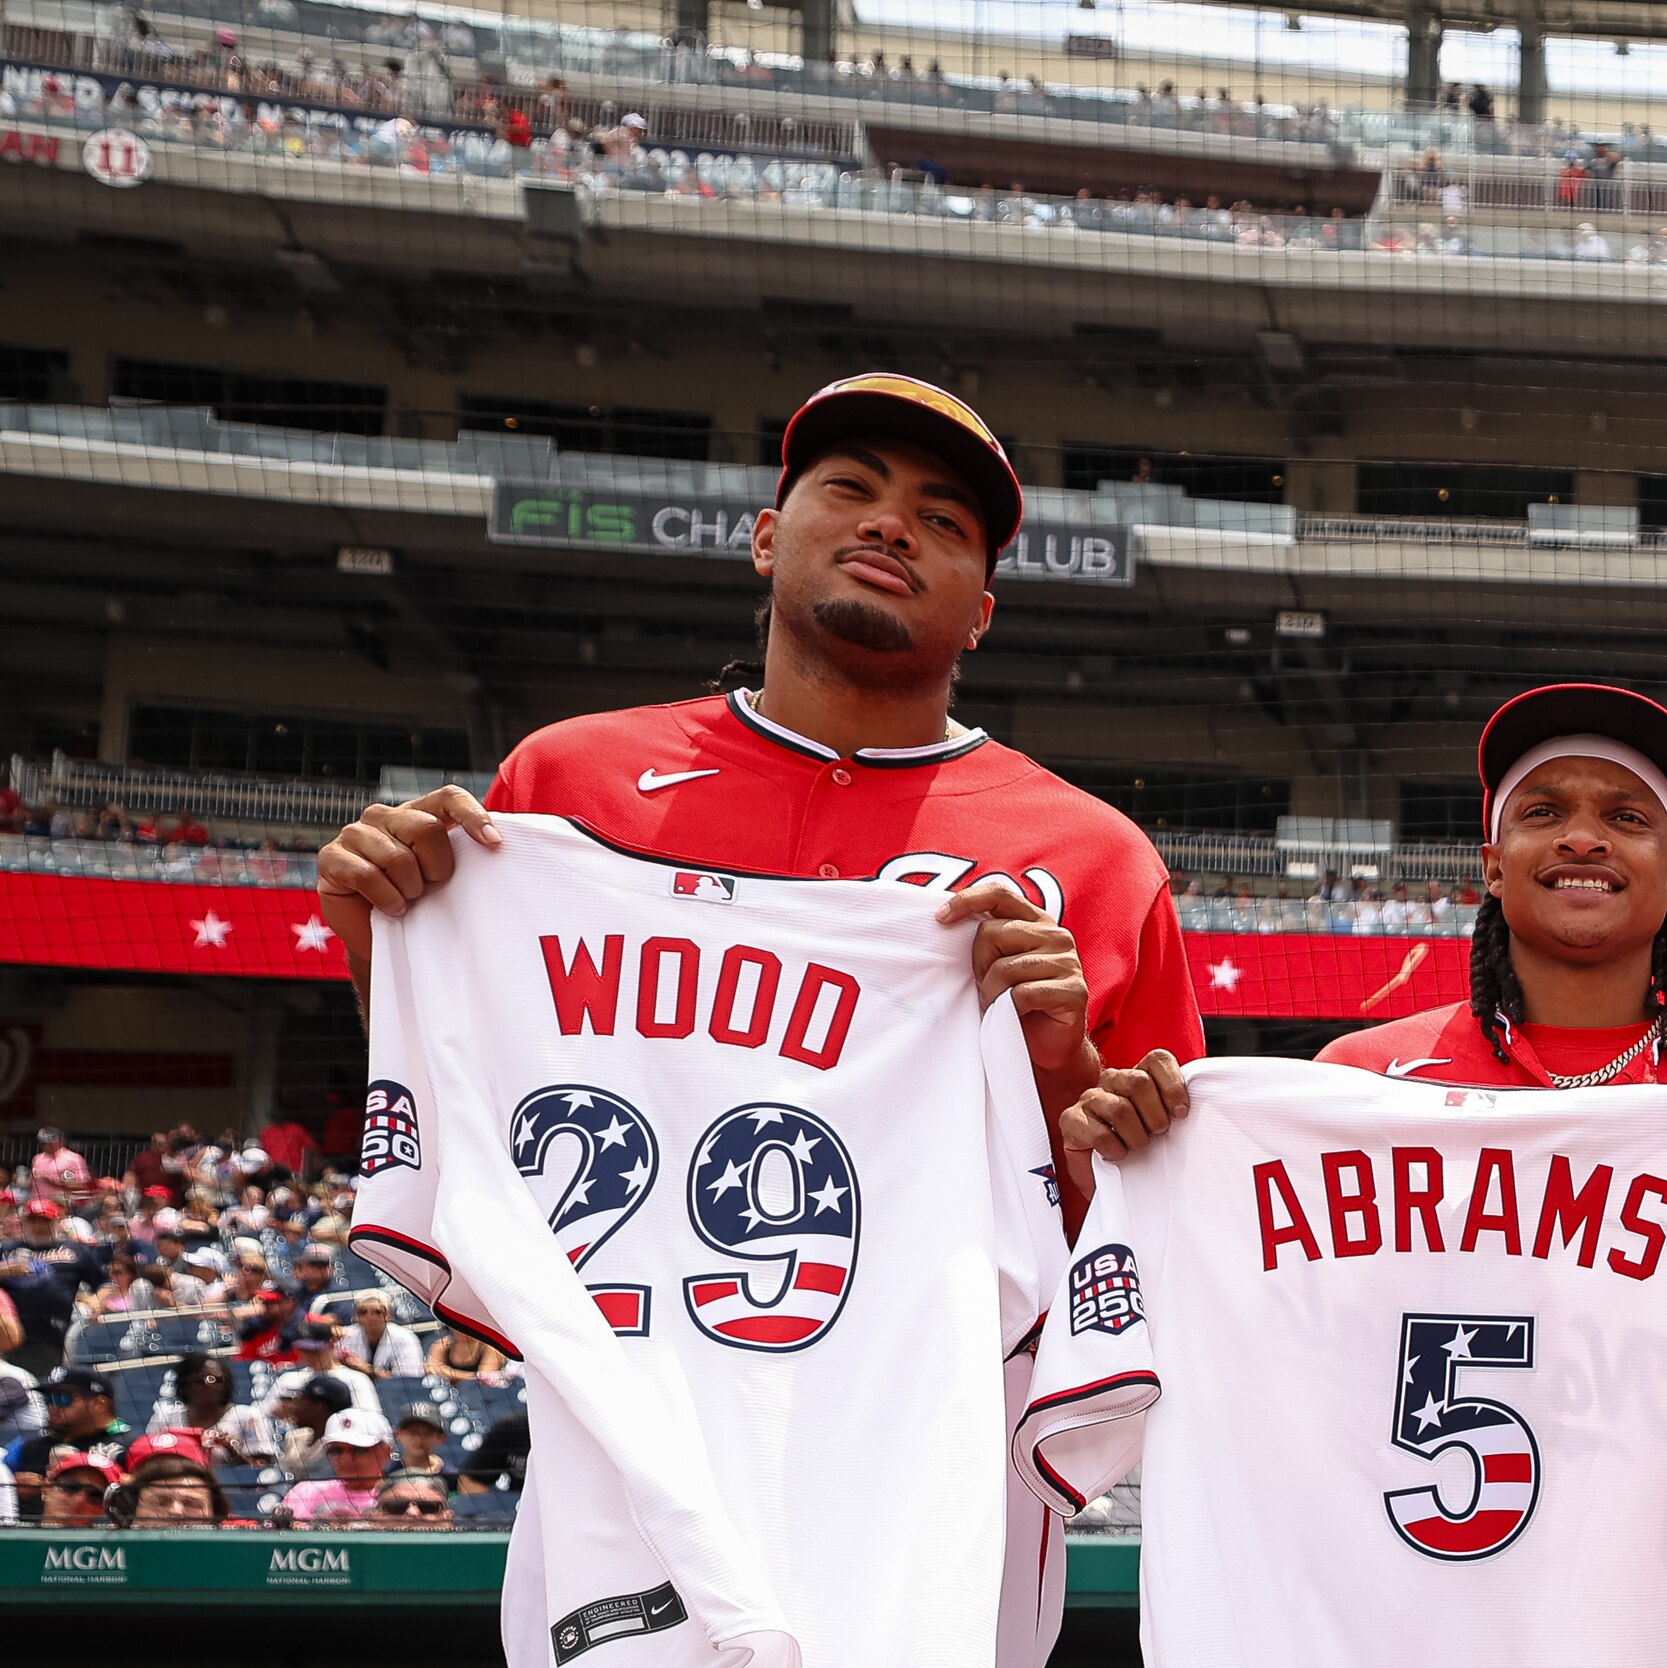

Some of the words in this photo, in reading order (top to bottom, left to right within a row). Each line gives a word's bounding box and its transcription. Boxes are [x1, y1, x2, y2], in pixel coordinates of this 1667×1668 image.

[98, 141, 137, 177] 11
[652, 507, 754, 548] CHA
[538, 933, 862, 1071] WOOD
[363, 1088, 418, 1126] SA
[361, 1129, 420, 1168] 50
[510, 1083, 862, 1352] 29
[1073, 1253, 1138, 1290] USA
[1384, 1312, 1543, 1563] 5
[43, 1546, 126, 1570] MGM
[270, 1548, 350, 1572] MGM
